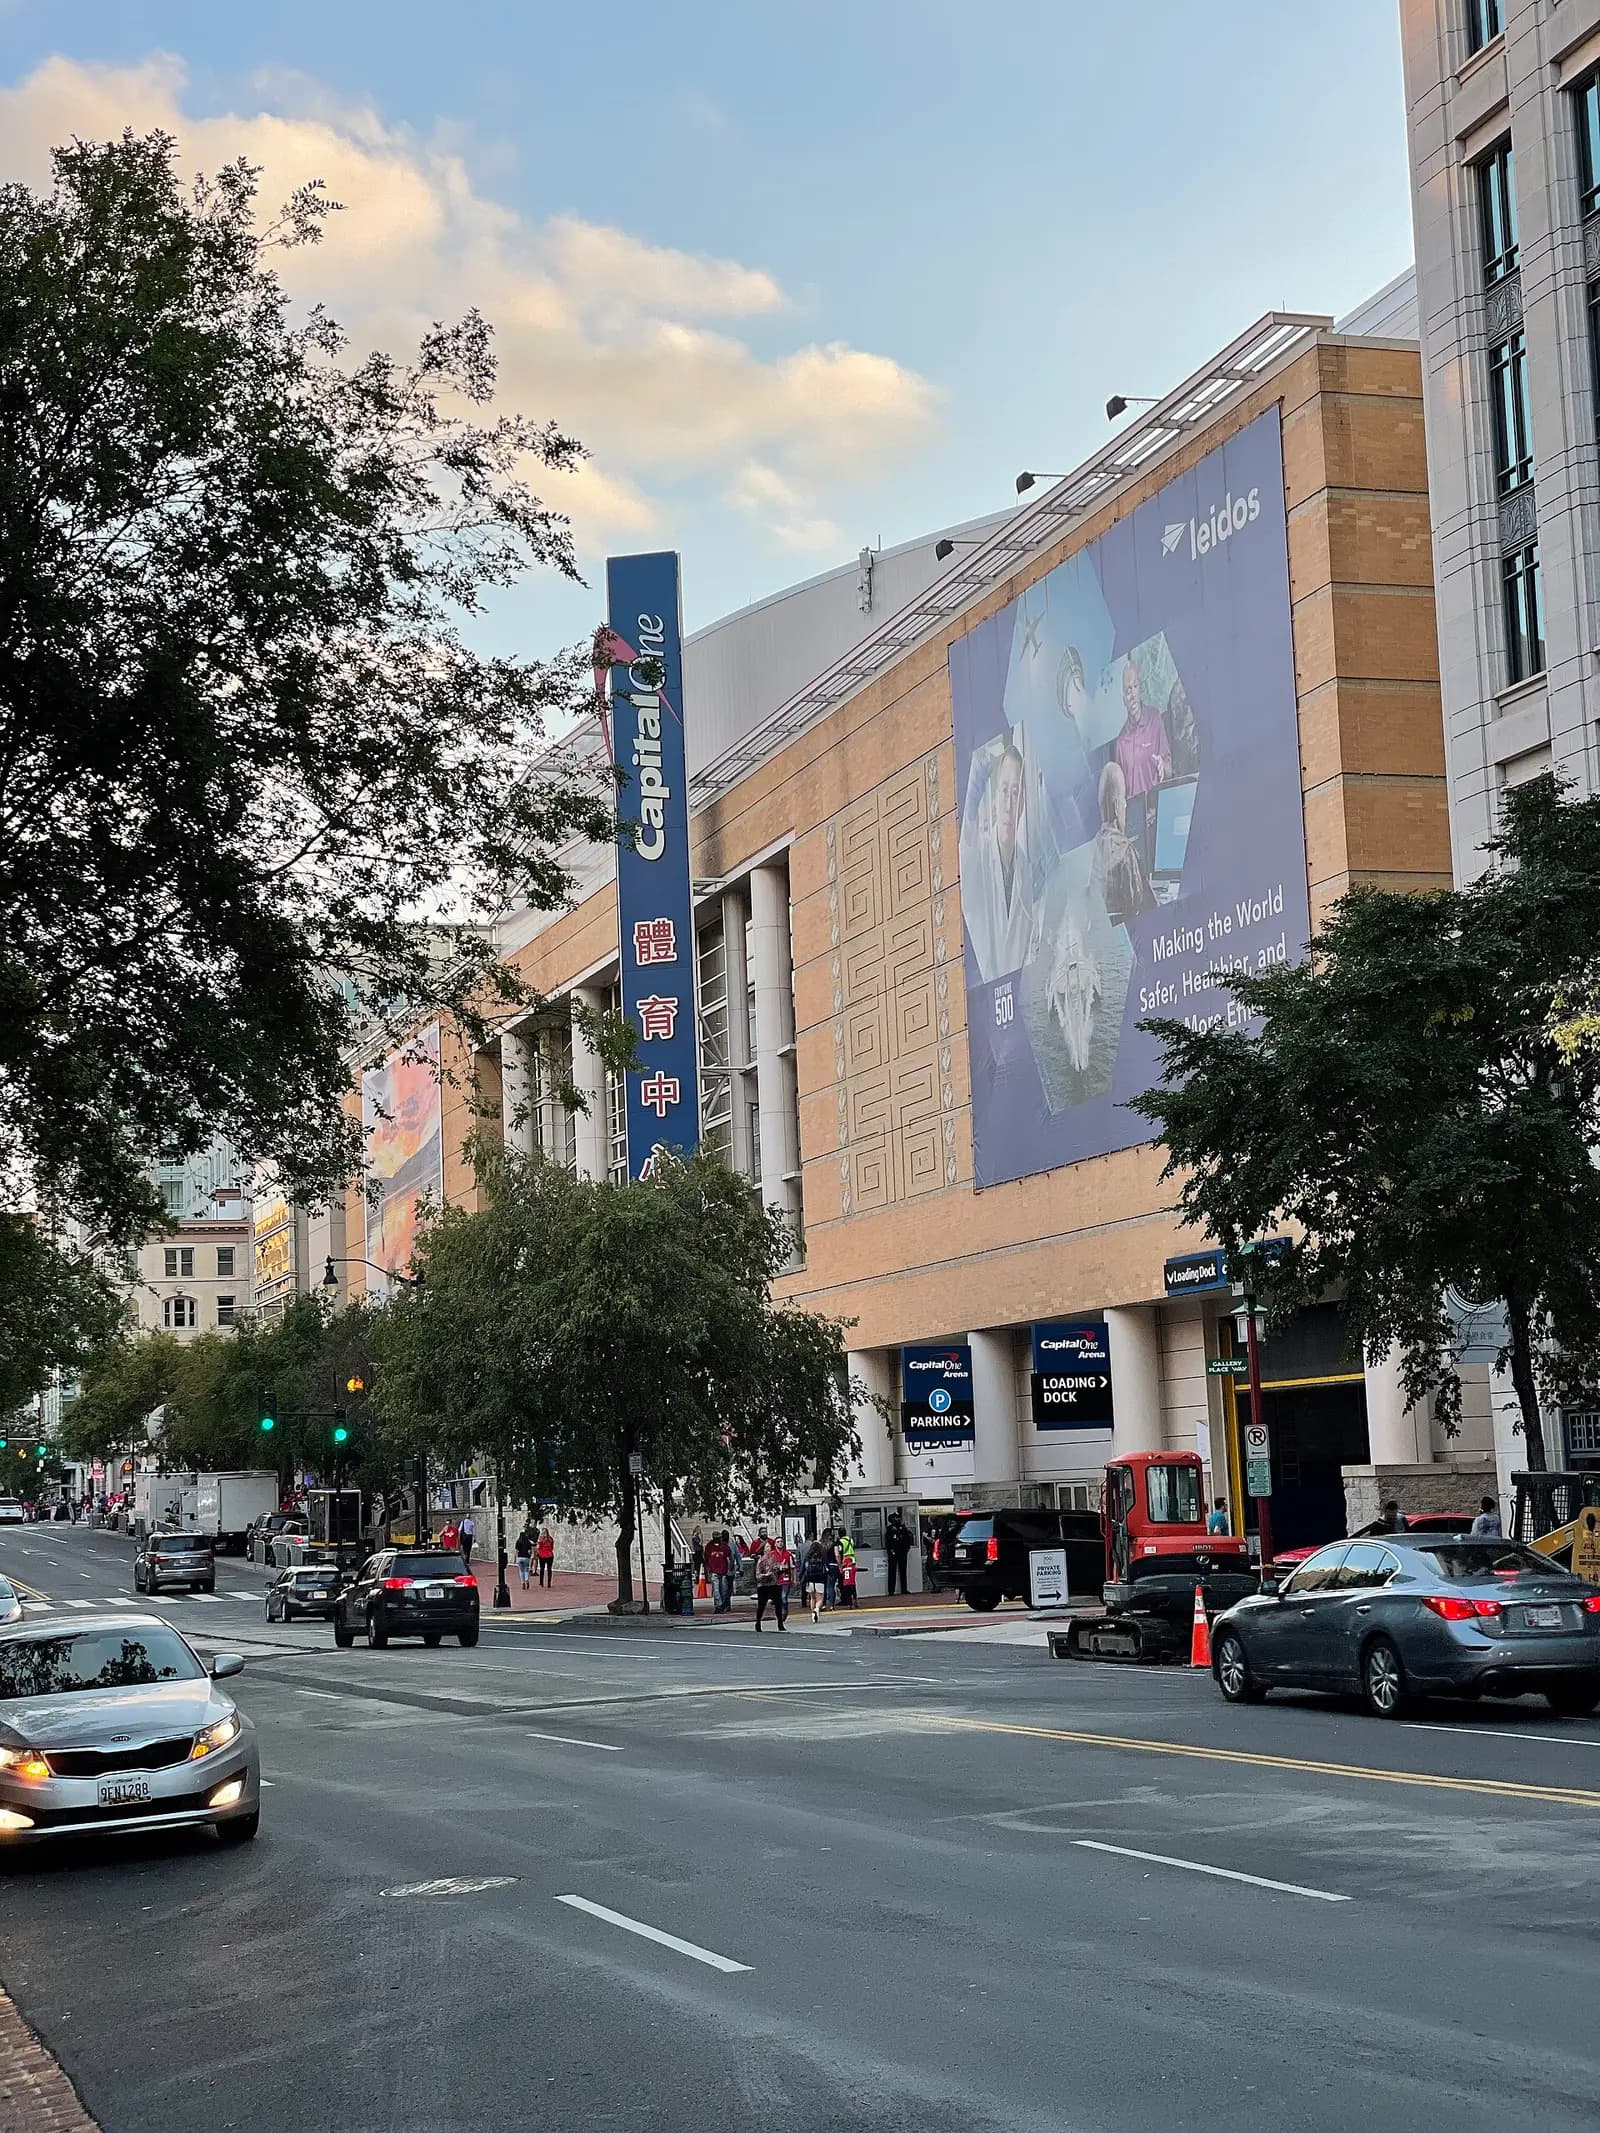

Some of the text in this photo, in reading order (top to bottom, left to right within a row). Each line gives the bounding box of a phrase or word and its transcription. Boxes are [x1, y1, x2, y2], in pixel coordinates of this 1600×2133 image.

[1190, 487, 1260, 561] leidos
[1152, 884, 1283, 963] Making the World
[1139, 980, 1178, 1013] Safer,
[1258, 932, 1286, 968] and
[995, 994, 1013, 1026] 500
[1173, 1267, 1200, 1283] Loading
[1200, 1263, 1217, 1279] Dock
[1077, 1351, 1106, 1359] Arena
[942, 1371, 969, 1379] Arena
[1042, 1376, 1096, 1390] LOADING
[1043, 1391, 1078, 1404] DOCK
[910, 1415, 961, 1428] PARKING
